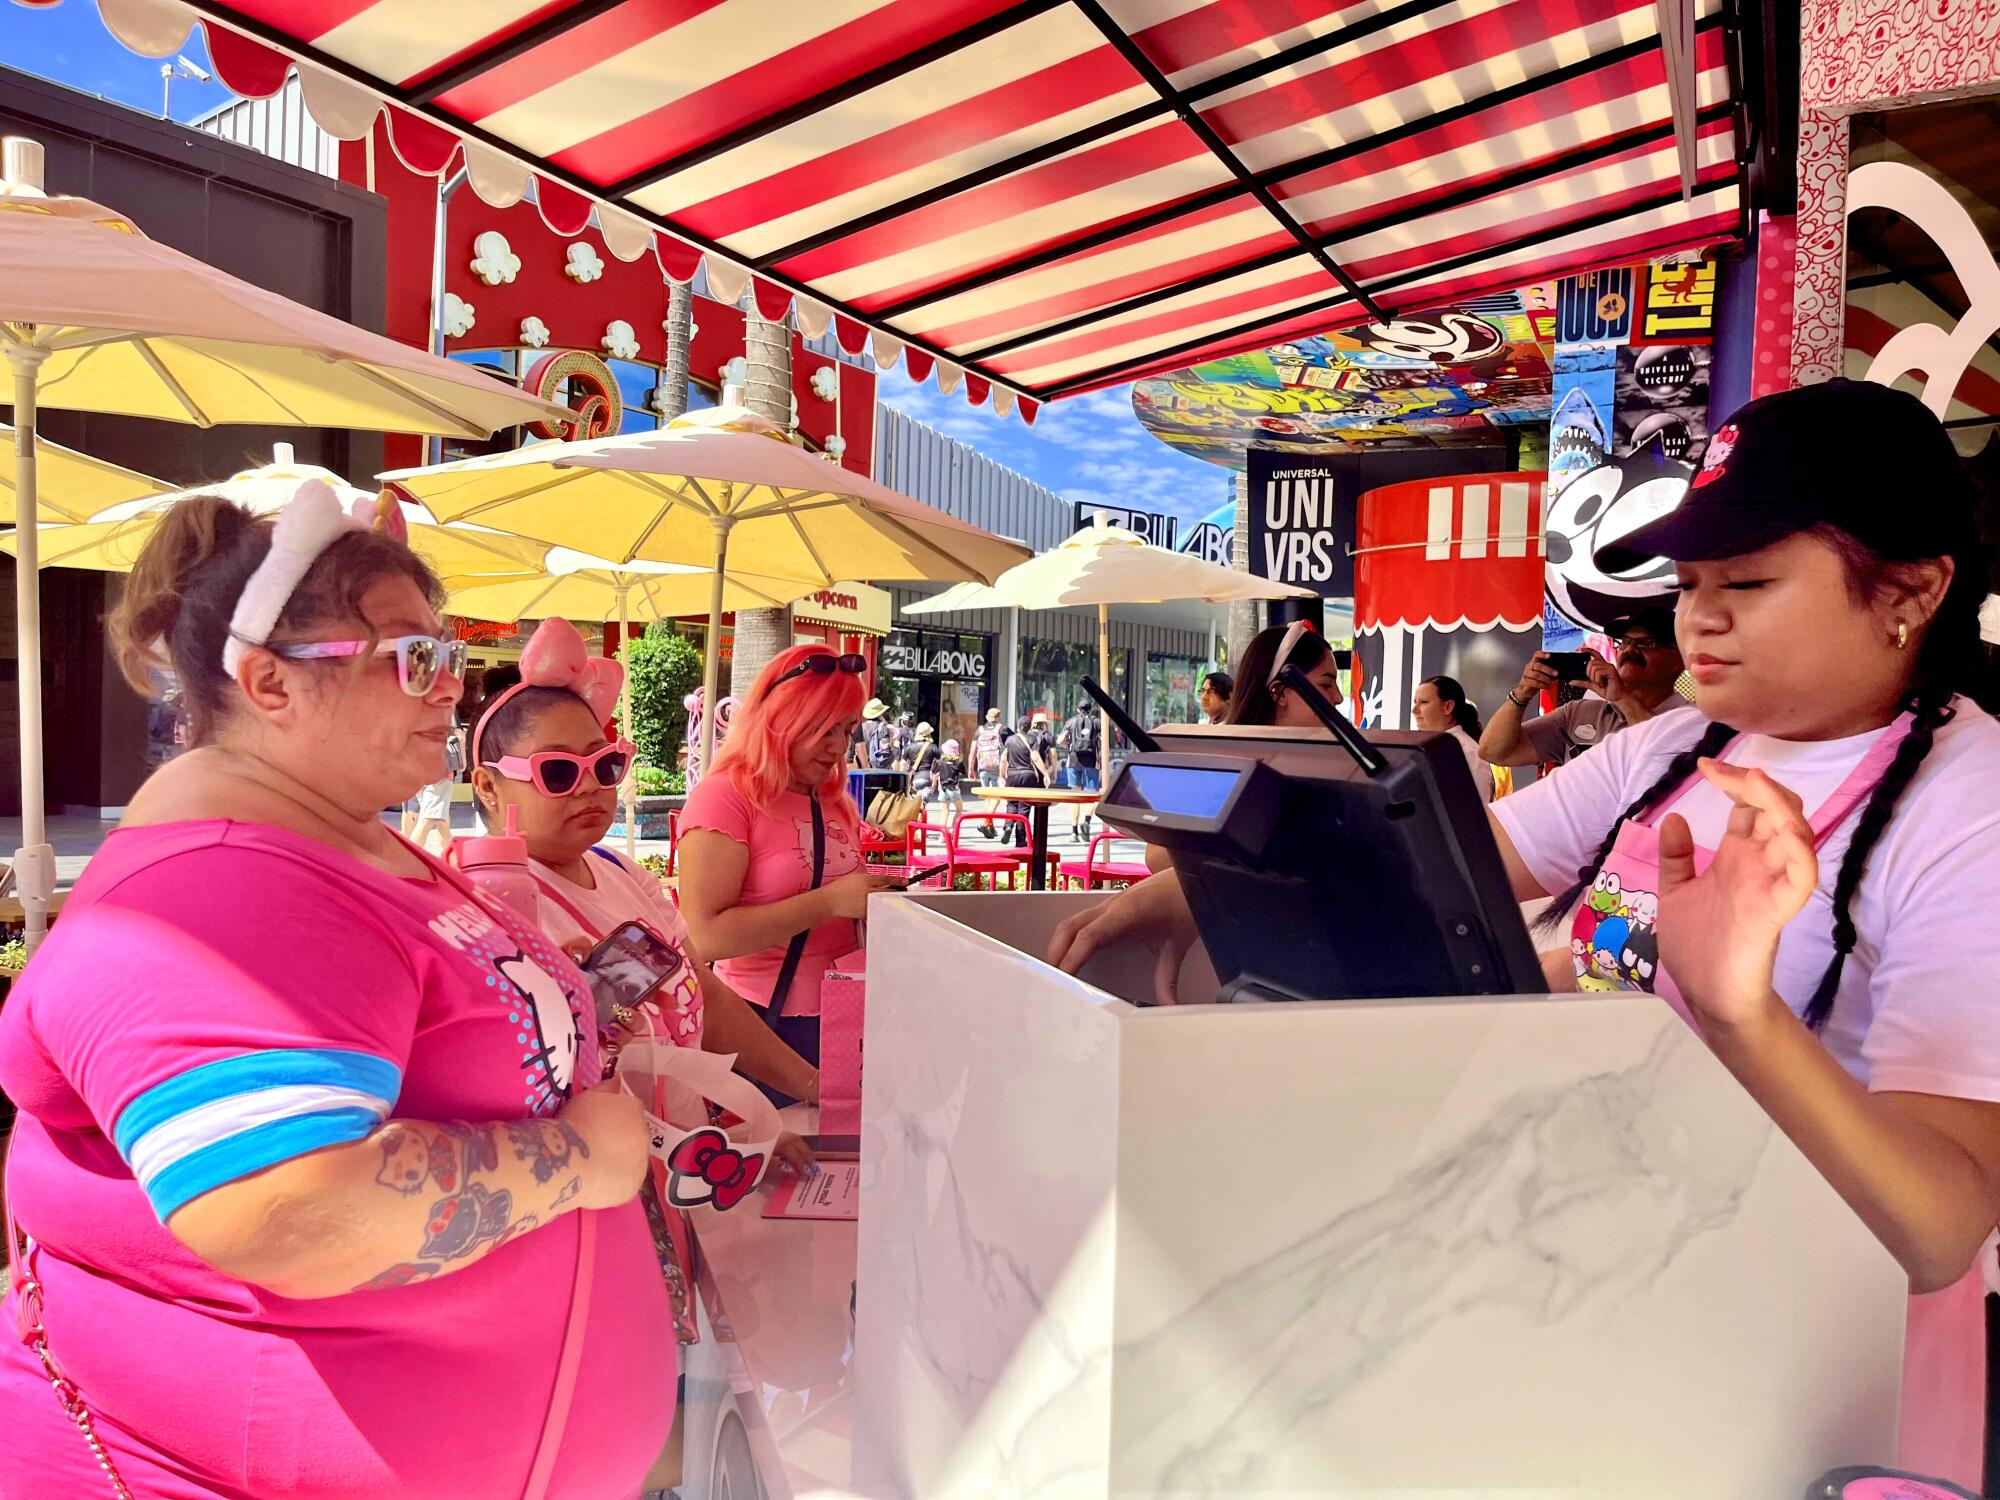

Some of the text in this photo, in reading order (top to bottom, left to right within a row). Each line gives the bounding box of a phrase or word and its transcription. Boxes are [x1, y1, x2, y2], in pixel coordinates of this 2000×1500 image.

[1640, 364, 1690, 374] UNIVERSAL
[1272, 468, 1331, 479] UNIVERSAL
[1265, 478, 1334, 529] UNI
[1264, 531, 1334, 582] VRS
[904, 647, 986, 676] BILLABONG
